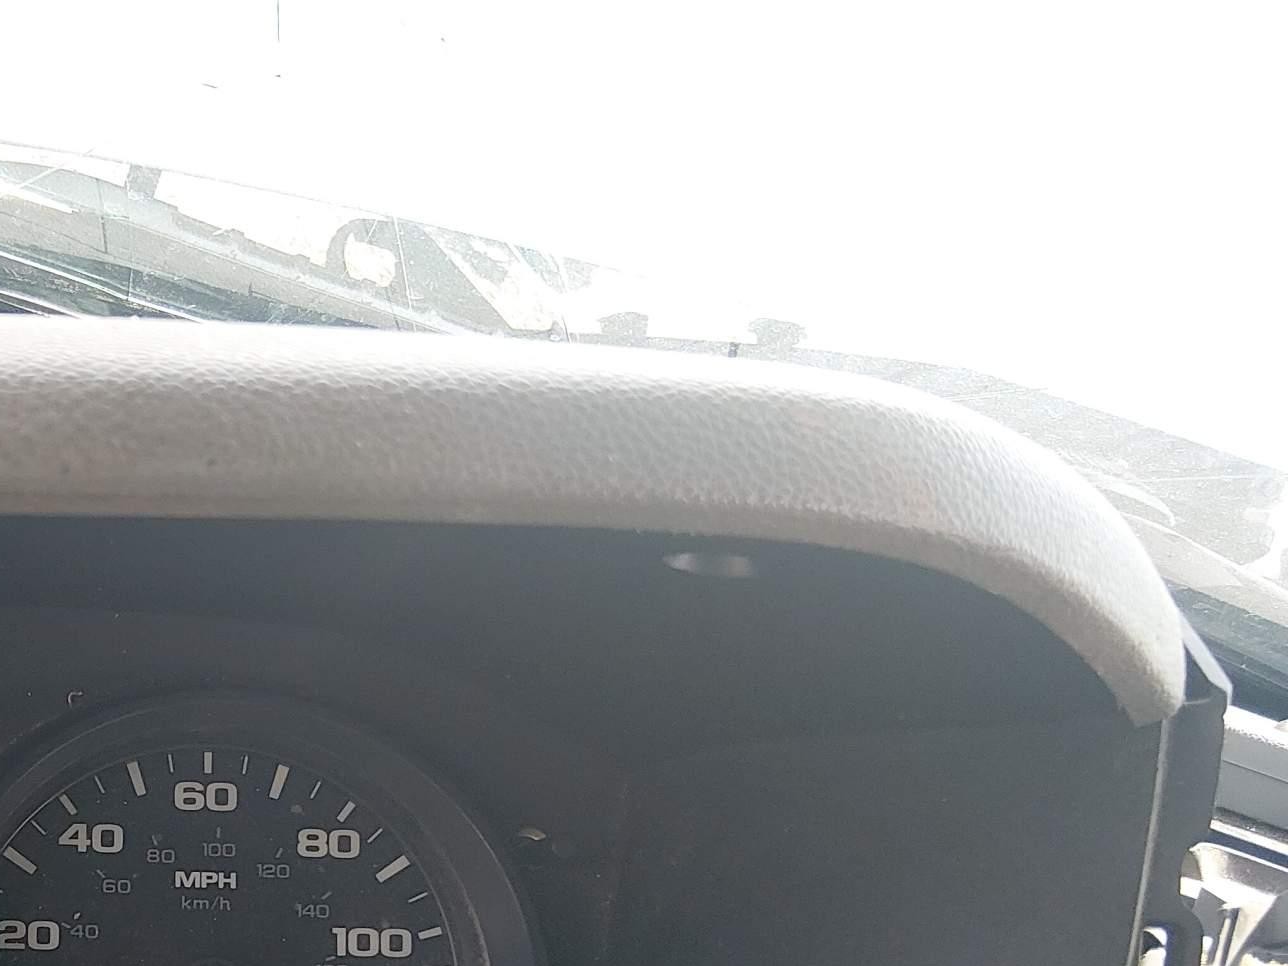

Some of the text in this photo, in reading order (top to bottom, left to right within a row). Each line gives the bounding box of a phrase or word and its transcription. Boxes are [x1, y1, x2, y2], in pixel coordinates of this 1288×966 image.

[173, 782, 238, 812] 60
[58, 824, 124, 853] 40
[297, 829, 360, 859] 80
[146, 848, 175, 865] 80
[202, 842, 236, 858] 100
[256, 863, 290, 879] 120
[102, 879, 131, 894] 60
[175, 871, 237, 890] MPH
[181, 895, 231, 911] km/h
[296, 903, 330, 919] 140
[70, 924, 99, 939] 40
[332, 927, 412, 958] 100
